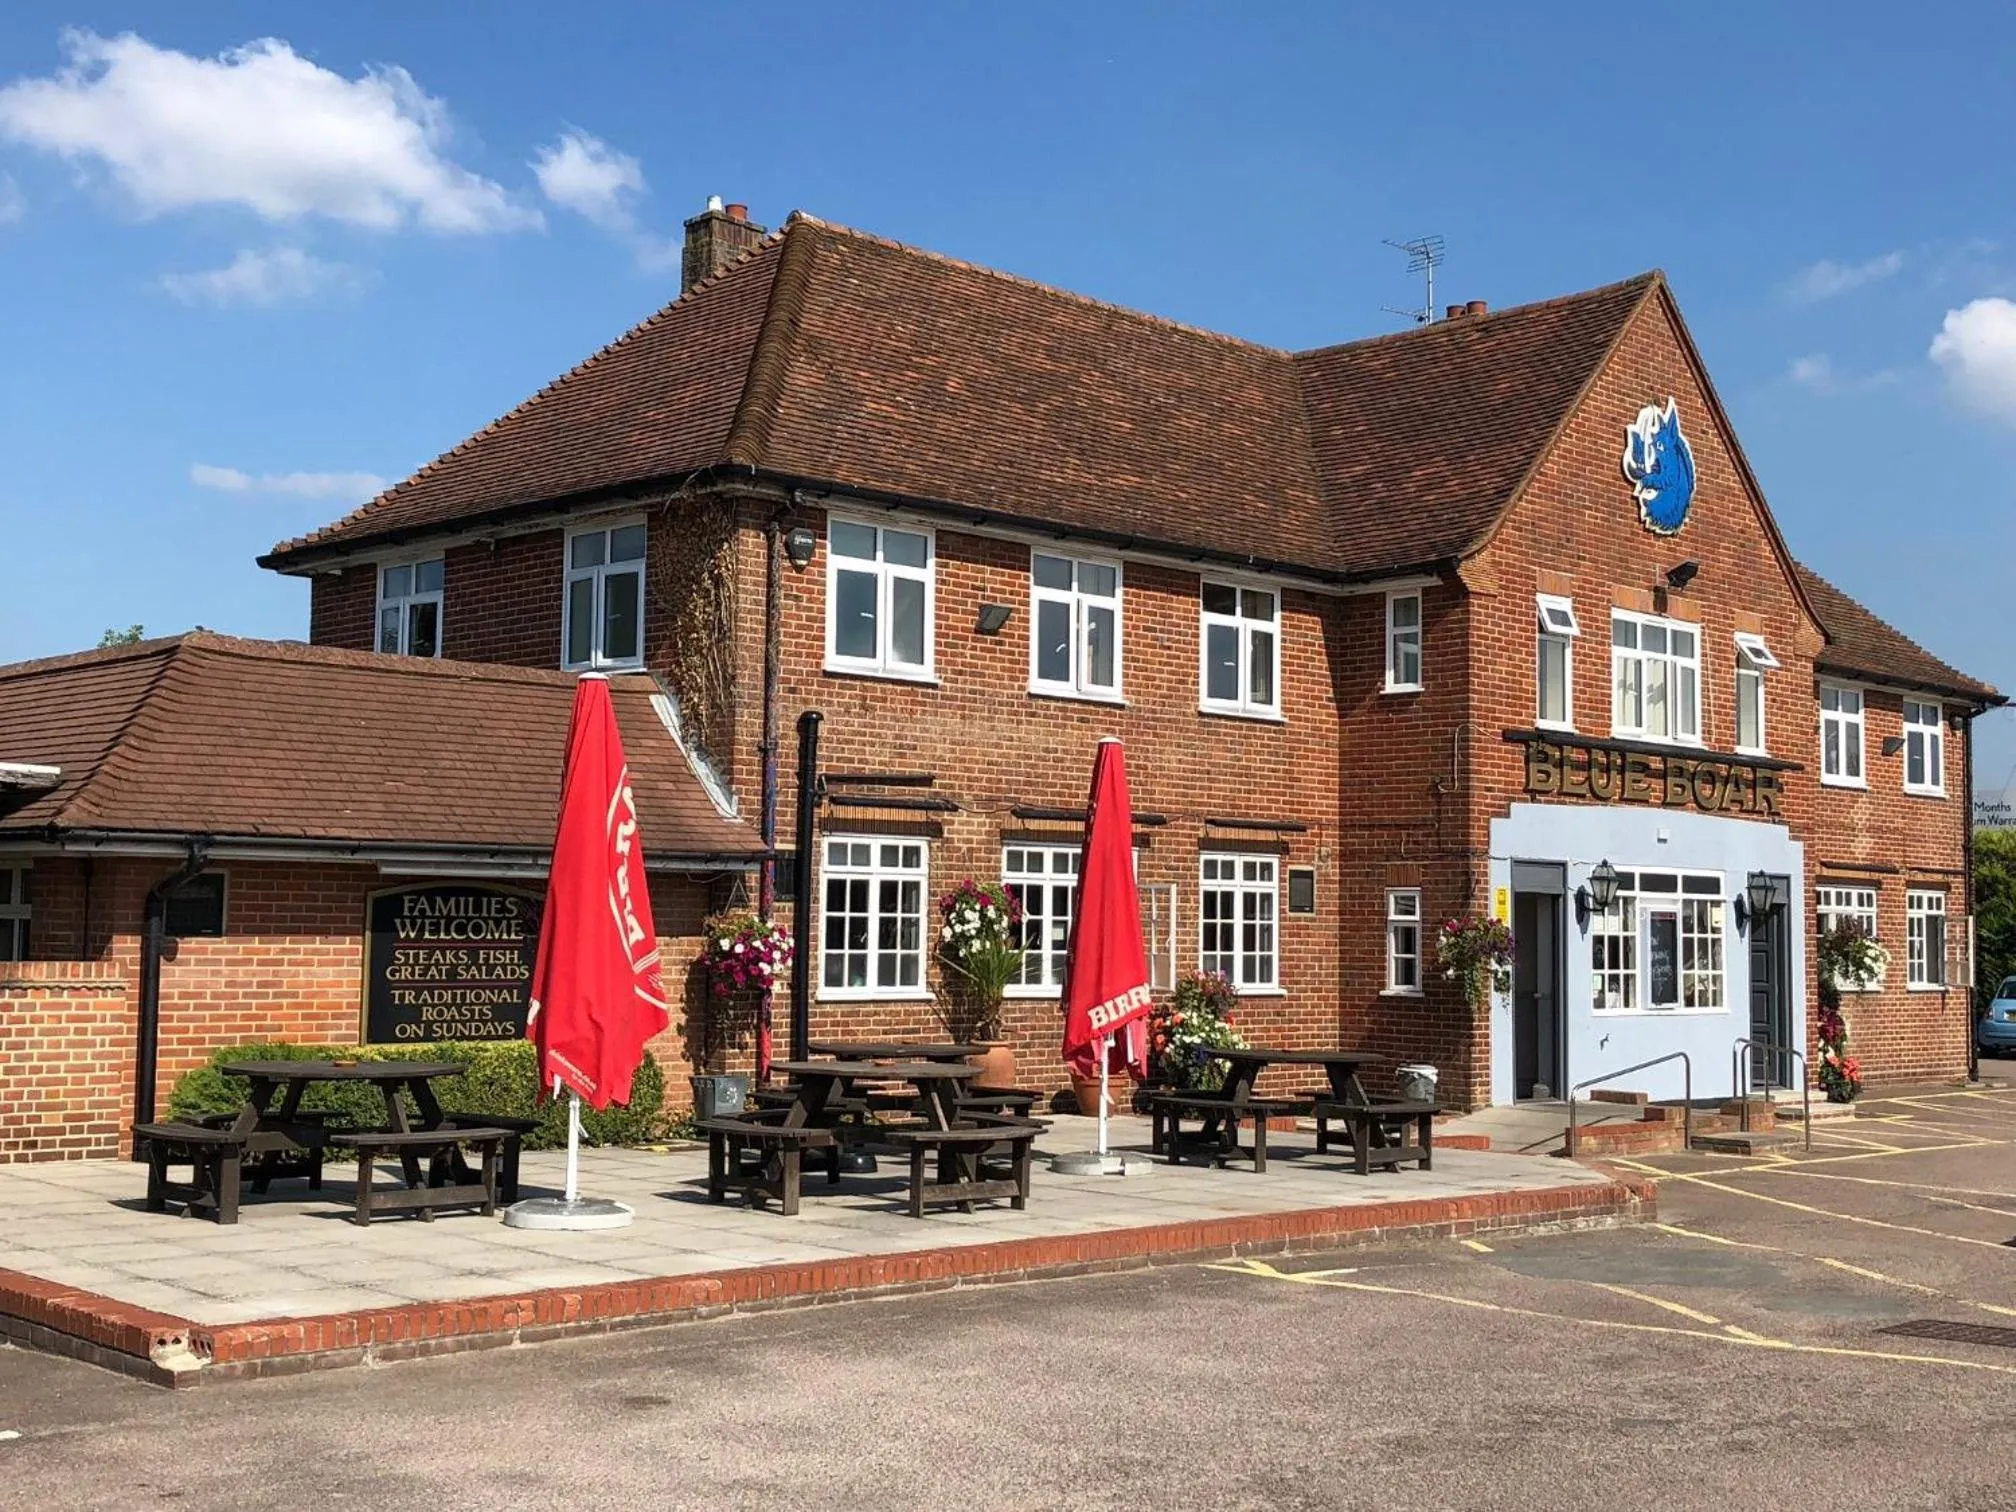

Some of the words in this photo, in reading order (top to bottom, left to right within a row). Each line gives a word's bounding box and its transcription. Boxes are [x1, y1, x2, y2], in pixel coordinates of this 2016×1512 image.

[1524, 741, 1650, 800] BLUE
[1662, 756, 1783, 816] BOAR
[402, 895, 518, 918] FAMILIES
[394, 918, 524, 940] WELCOME
[394, 949, 472, 965] STEAKS,
[385, 965, 450, 980] GREAT
[456, 965, 529, 980] SALADS
[390, 988, 522, 1005] TRADITIONAL
[421, 1005, 493, 1021] ROASTS
[395, 1022, 425, 1039] ON
[432, 1021, 516, 1038] SUNDAYS
